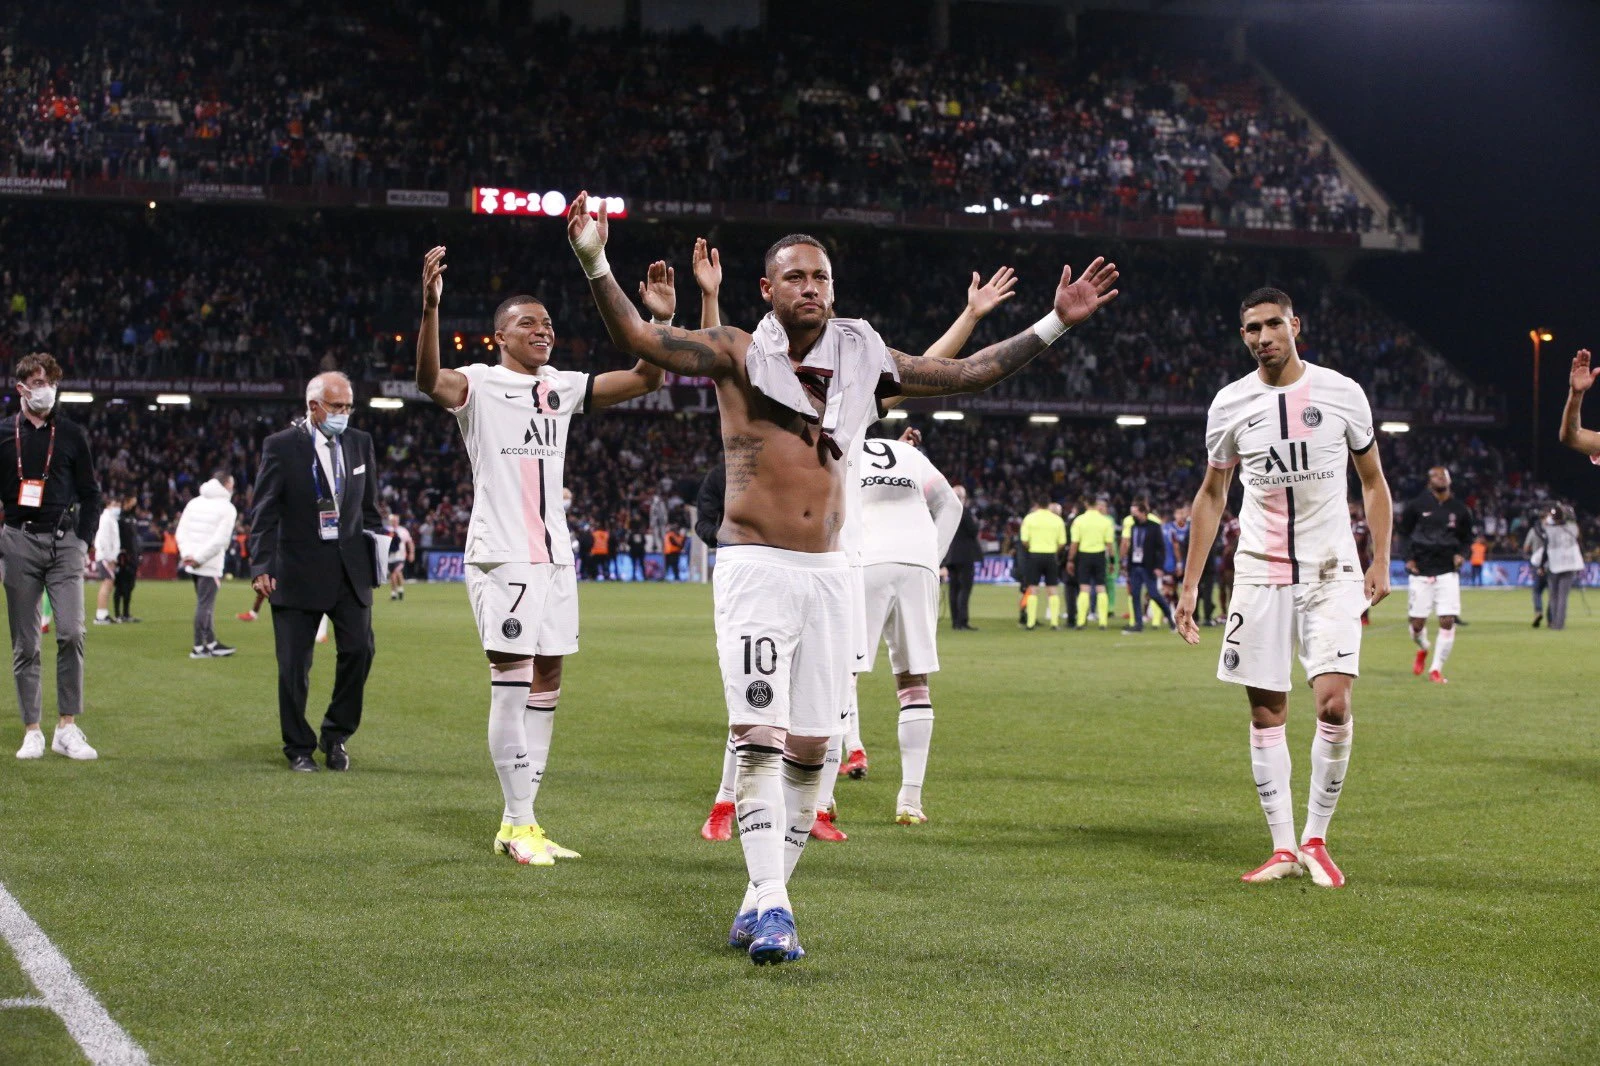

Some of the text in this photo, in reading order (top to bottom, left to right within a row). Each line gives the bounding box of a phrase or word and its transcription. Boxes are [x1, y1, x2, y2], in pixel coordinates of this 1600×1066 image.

[531, 448, 545, 456] LIVE
[863, 442, 897, 470] 9
[1272, 476, 1291, 485] LIVE
[1293, 471, 1335, 483] LIMITLESS
[508, 582, 527, 613] 7
[1226, 611, 1244, 646] 2
[740, 635, 778, 676] 10
[1259, 789, 1277, 797] ARIS
[740, 821, 772, 836] PARIS
